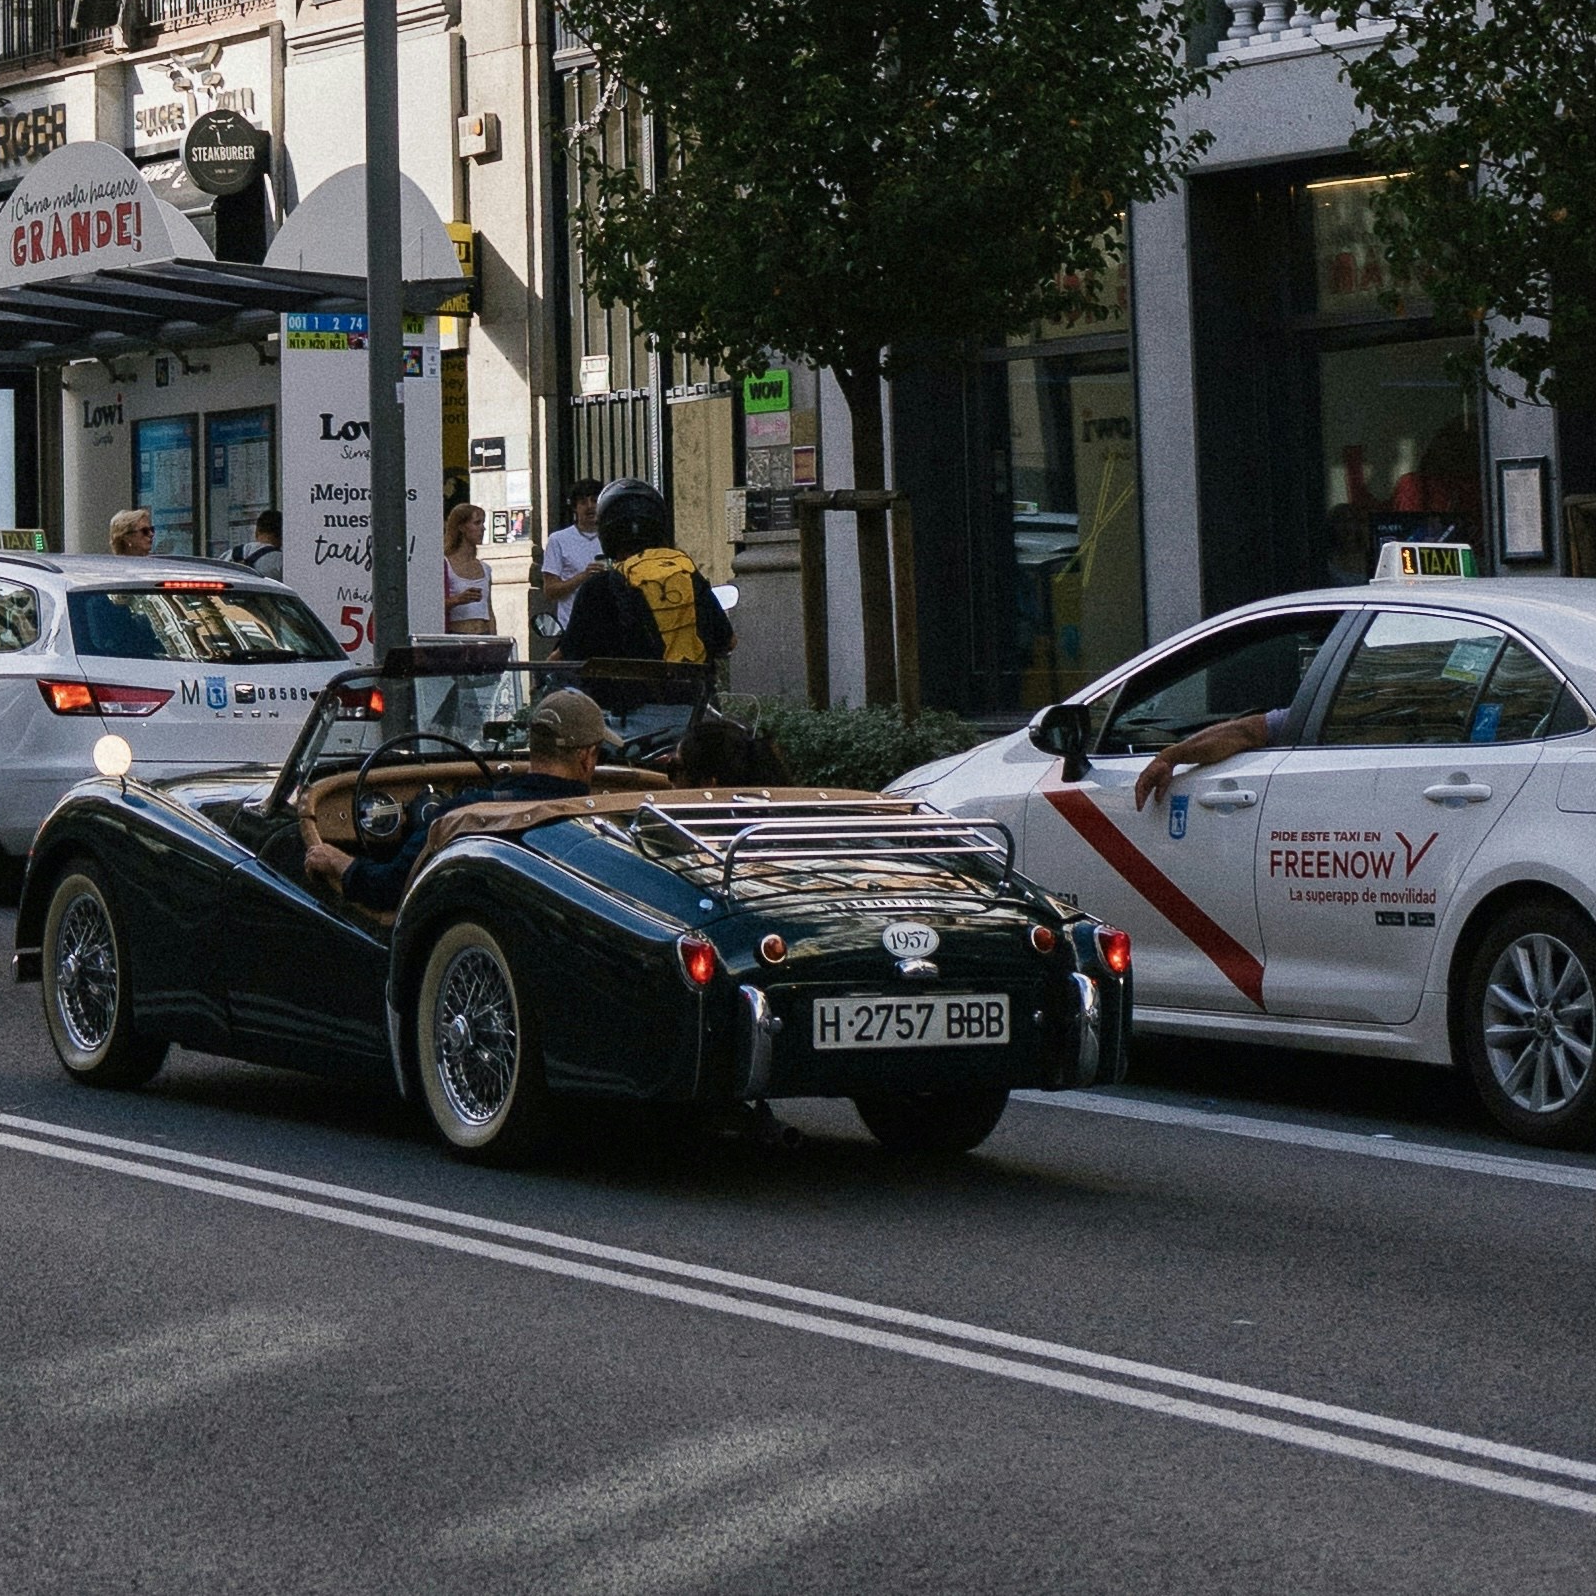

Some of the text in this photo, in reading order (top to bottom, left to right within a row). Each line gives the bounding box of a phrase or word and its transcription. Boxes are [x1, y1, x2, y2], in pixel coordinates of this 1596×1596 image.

[192, 145, 254, 162] STEAKBURGER
[10, 201, 142, 267] GRANDE!
[289, 316, 363, 329] 001 1 2 74
[289, 338, 346, 349] N19 N20 N21
[749, 380, 783, 400] WOW
[83, 392, 124, 428] Lowi
[1419, 549, 1459, 574] TAXI
[181, 680, 308, 705] M 08589
[1270, 831, 1381, 842] PIDE ESTE TAXI EN
[1270, 850, 1395, 880] FREENOW
[1289, 887, 1437, 905] La superapp de movilidad
[889, 931, 931, 950] 1957
[946, 1001, 1005, 1039] BBB
